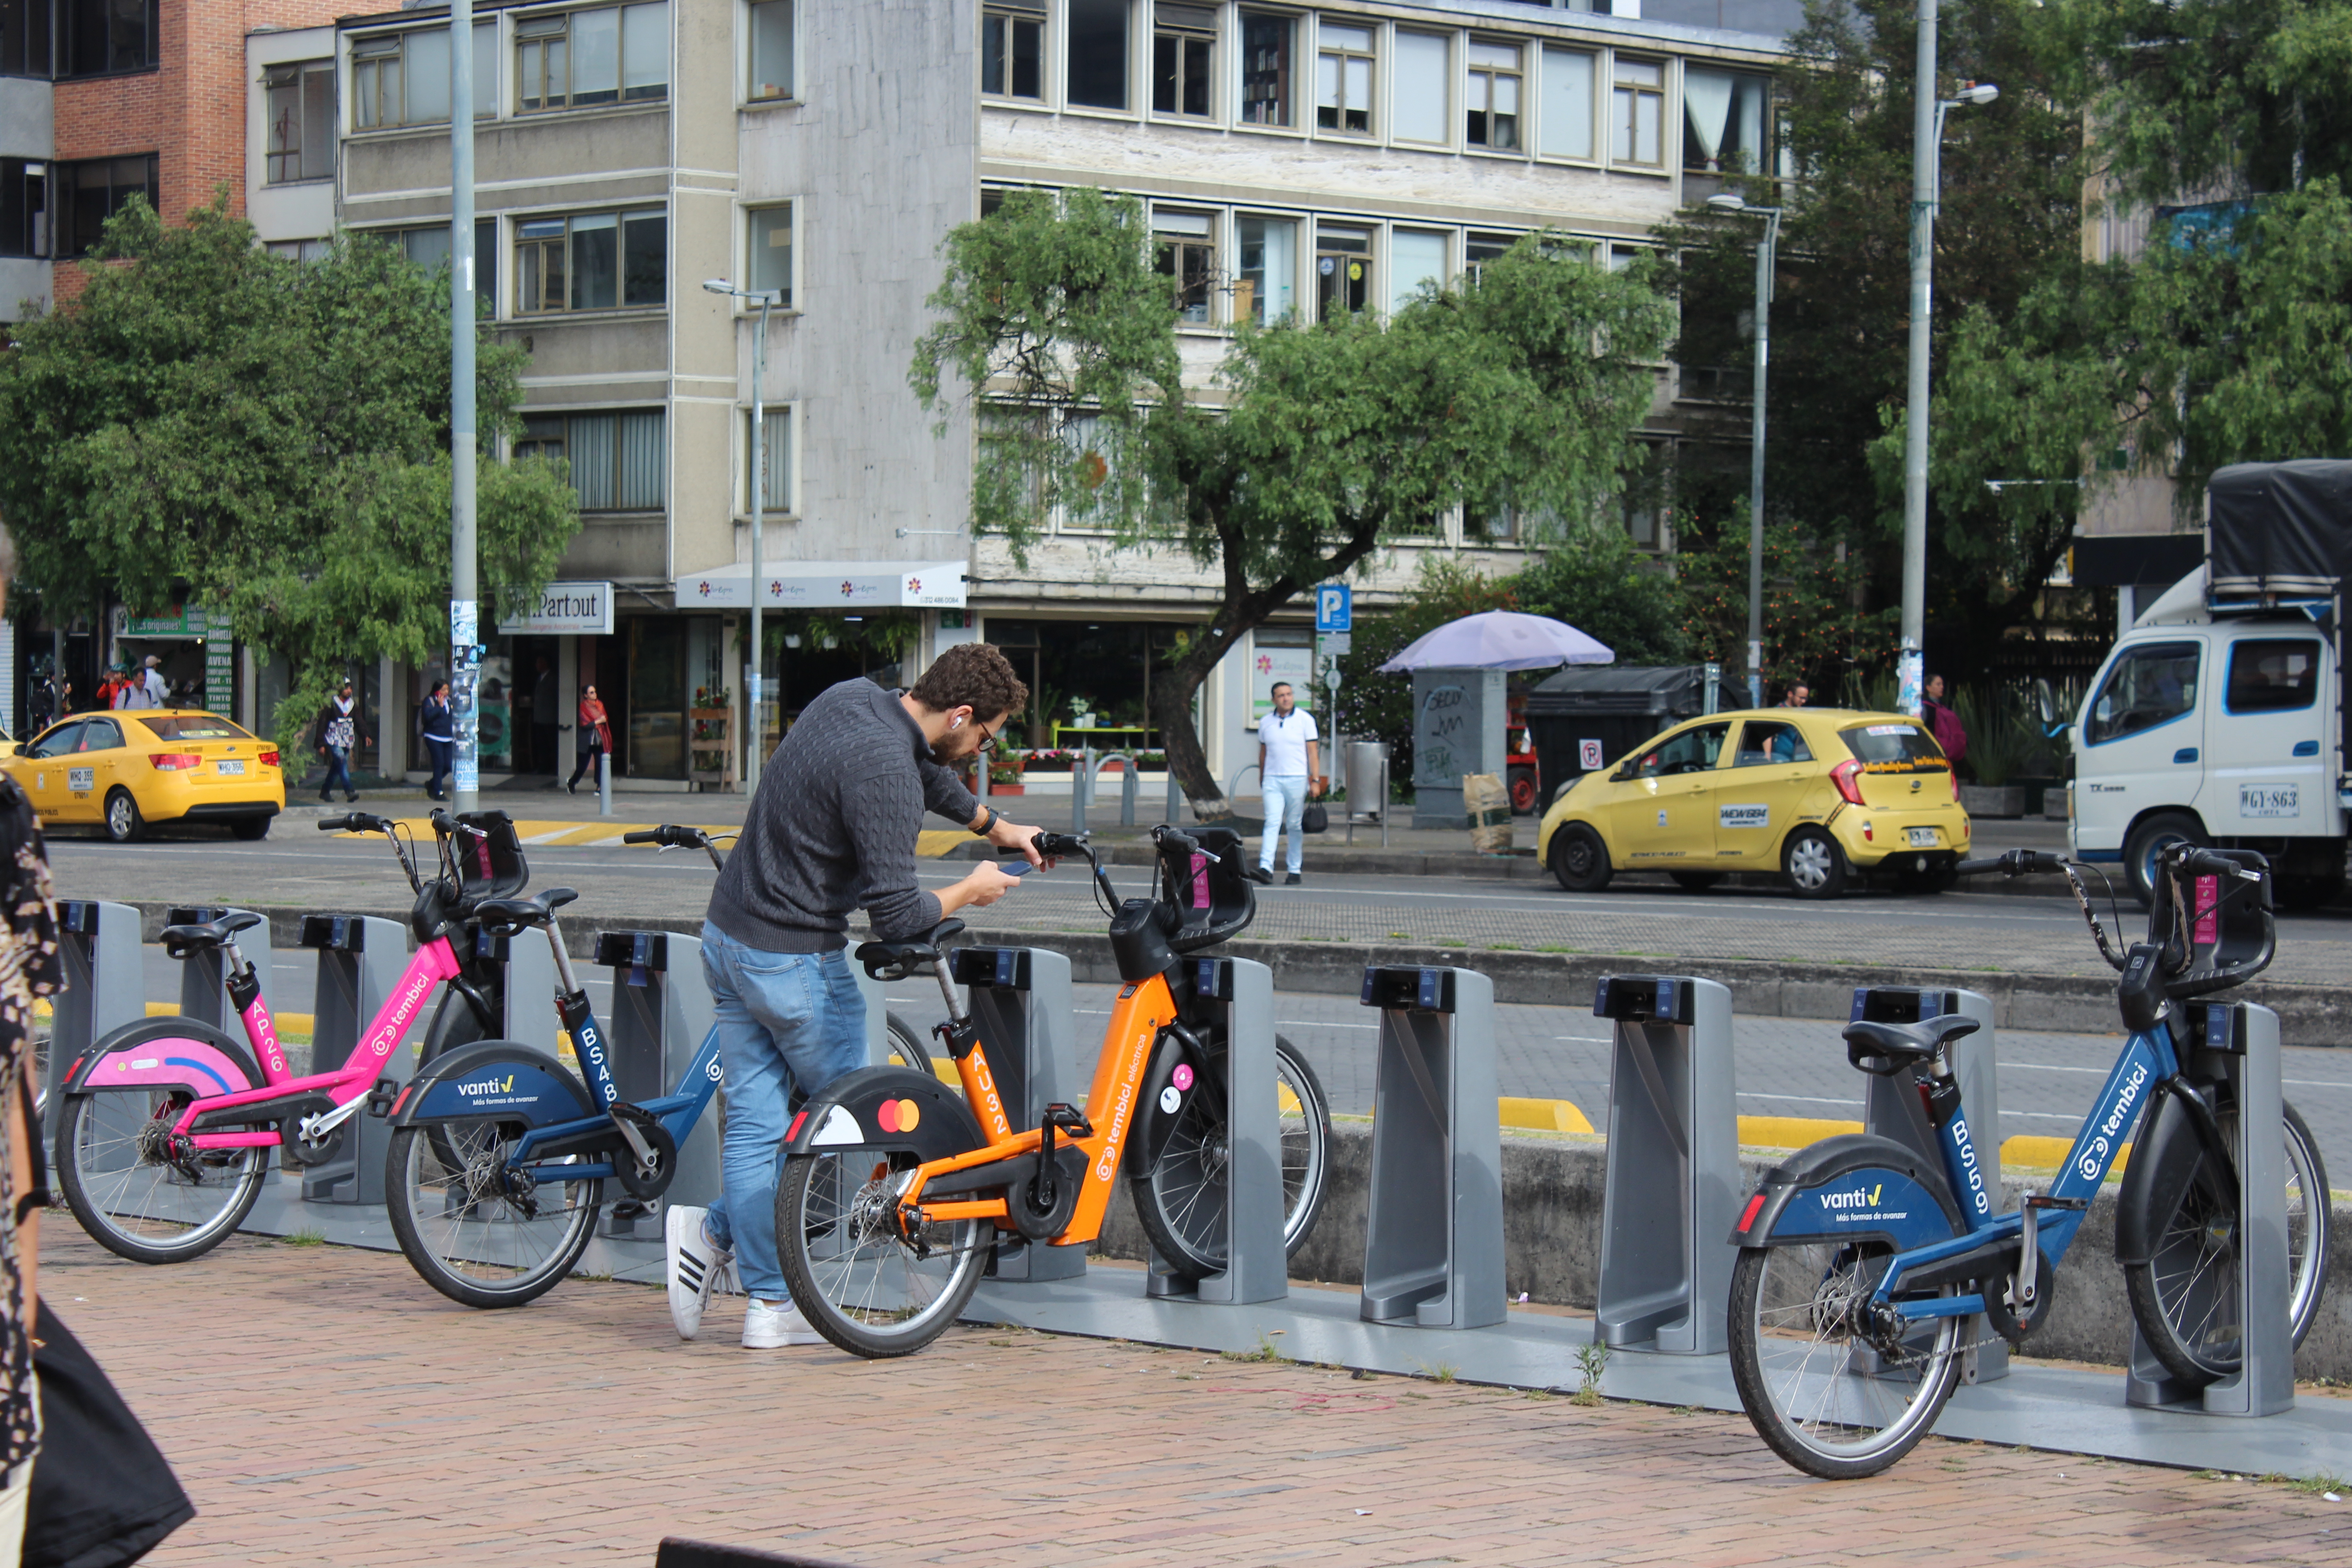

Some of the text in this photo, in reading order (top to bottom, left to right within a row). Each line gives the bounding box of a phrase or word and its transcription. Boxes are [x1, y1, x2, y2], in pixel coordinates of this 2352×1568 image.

[1322, 591, 1343, 623] P
[147, 620, 181, 633] originales!
[208, 656, 232, 666] AVENA
[1588, 747, 1597, 762] P
[391, 972, 430, 1025] tembici
[253, 1000, 284, 1073] AP26
[581, 1027, 617, 1102] BS48
[457, 1077, 500, 1097] vanti
[472, 1098, 485, 1106] Más
[485, 1097, 507, 1105] formas
[973, 1051, 1007, 1135] AU32
[1107, 1034, 1147, 1144] tembici eléctrica
[2102, 1061, 2148, 1137] tembici
[1951, 1119, 1989, 1215] BS59
[1820, 1186, 1866, 1210] vanti
[1836, 1211, 1908, 1222] Más formas de avanzar
